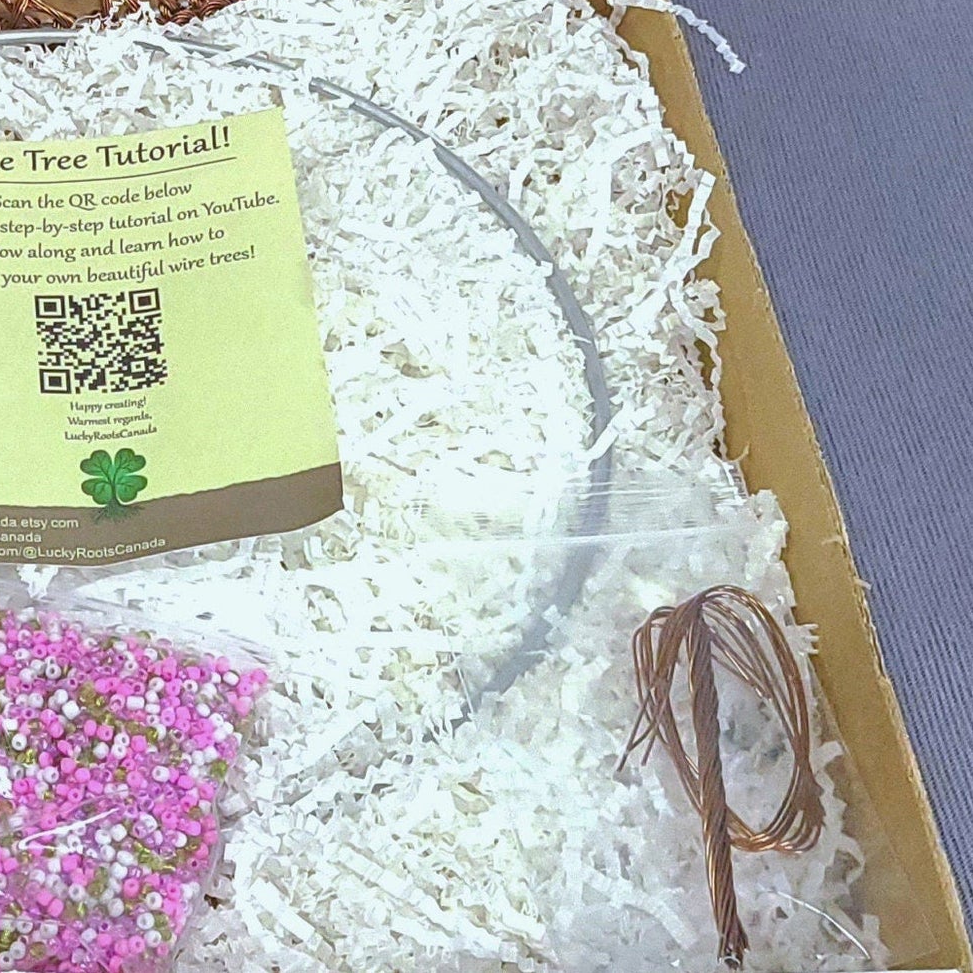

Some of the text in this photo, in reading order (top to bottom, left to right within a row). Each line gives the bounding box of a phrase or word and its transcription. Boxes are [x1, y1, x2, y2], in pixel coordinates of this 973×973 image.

[23, 149, 88, 171] Tree
[96, 126, 231, 167] Tutorial!
[37, 193, 65, 209] the
[69, 193, 97, 211] QR
[101, 188, 140, 206] code
[144, 181, 192, 202] below
[0, 214, 104, 237] step-by-step
[108, 209, 172, 230] tutorial
[176, 208, 198, 222] on
[201, 191, 280, 216] YouTube.
[27, 242, 76, 262] along
[81, 241, 114, 257] and
[119, 237, 163, 255] learn
[167, 230, 204, 248] how
[207, 226, 225, 241] to
[1, 272, 42, 288] your
[46, 271, 82, 285] own
[87, 260, 165, 284] beautiful
[169, 255, 205, 272] wire
[209, 245, 256, 265] trees!
[67, 411, 152, 425] Warmest regards,
[70, 396, 146, 413] Happy creating!
[65, 423, 157, 443] LuckyRootsCanada
